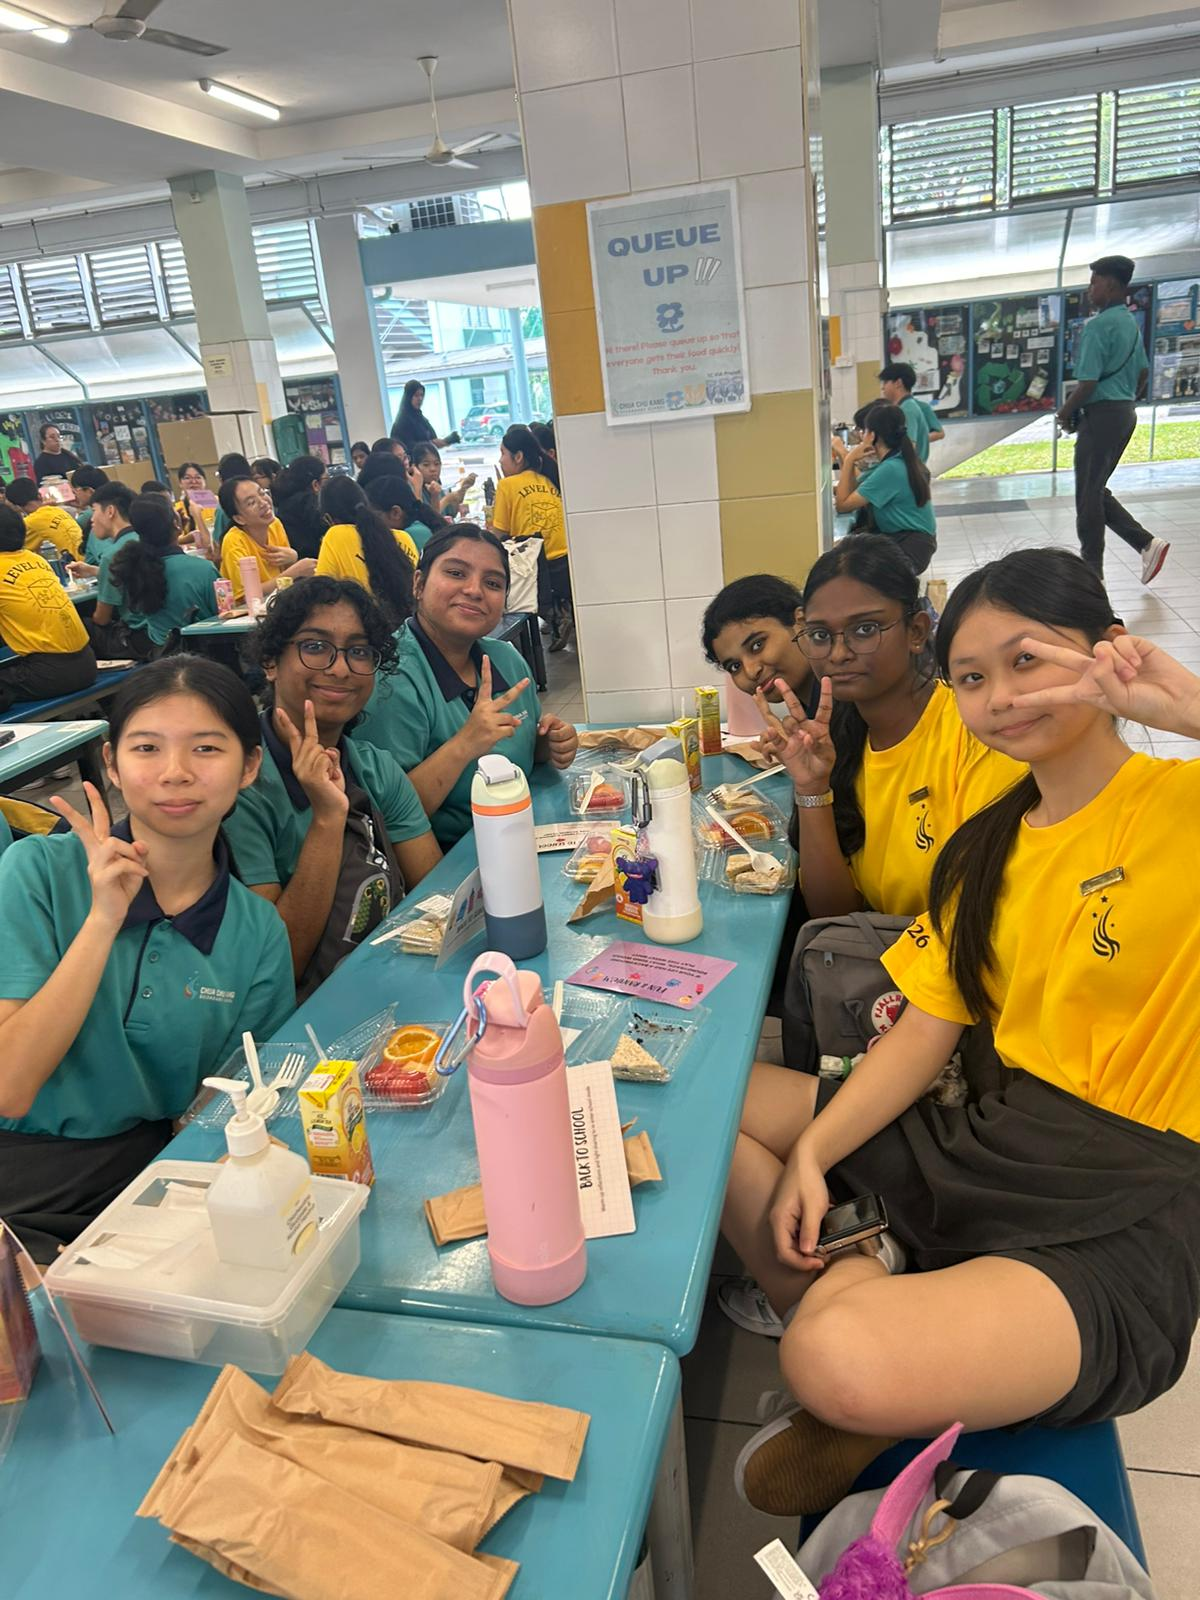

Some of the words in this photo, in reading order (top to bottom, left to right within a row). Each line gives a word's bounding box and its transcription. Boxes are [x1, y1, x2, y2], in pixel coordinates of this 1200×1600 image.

[608, 223, 720, 257] QUEUE
[643, 264, 689, 287] UP
[606, 358, 644, 368] everyone
[518, 485, 548, 498] LEVEL
[4, 562, 37, 584] LEVEL
[646, 984, 667, 993] FUN
[571, 1106, 588, 1145] SCHOOL
[576, 1147, 589, 1162] TO
[578, 1162, 593, 1189] BACK
